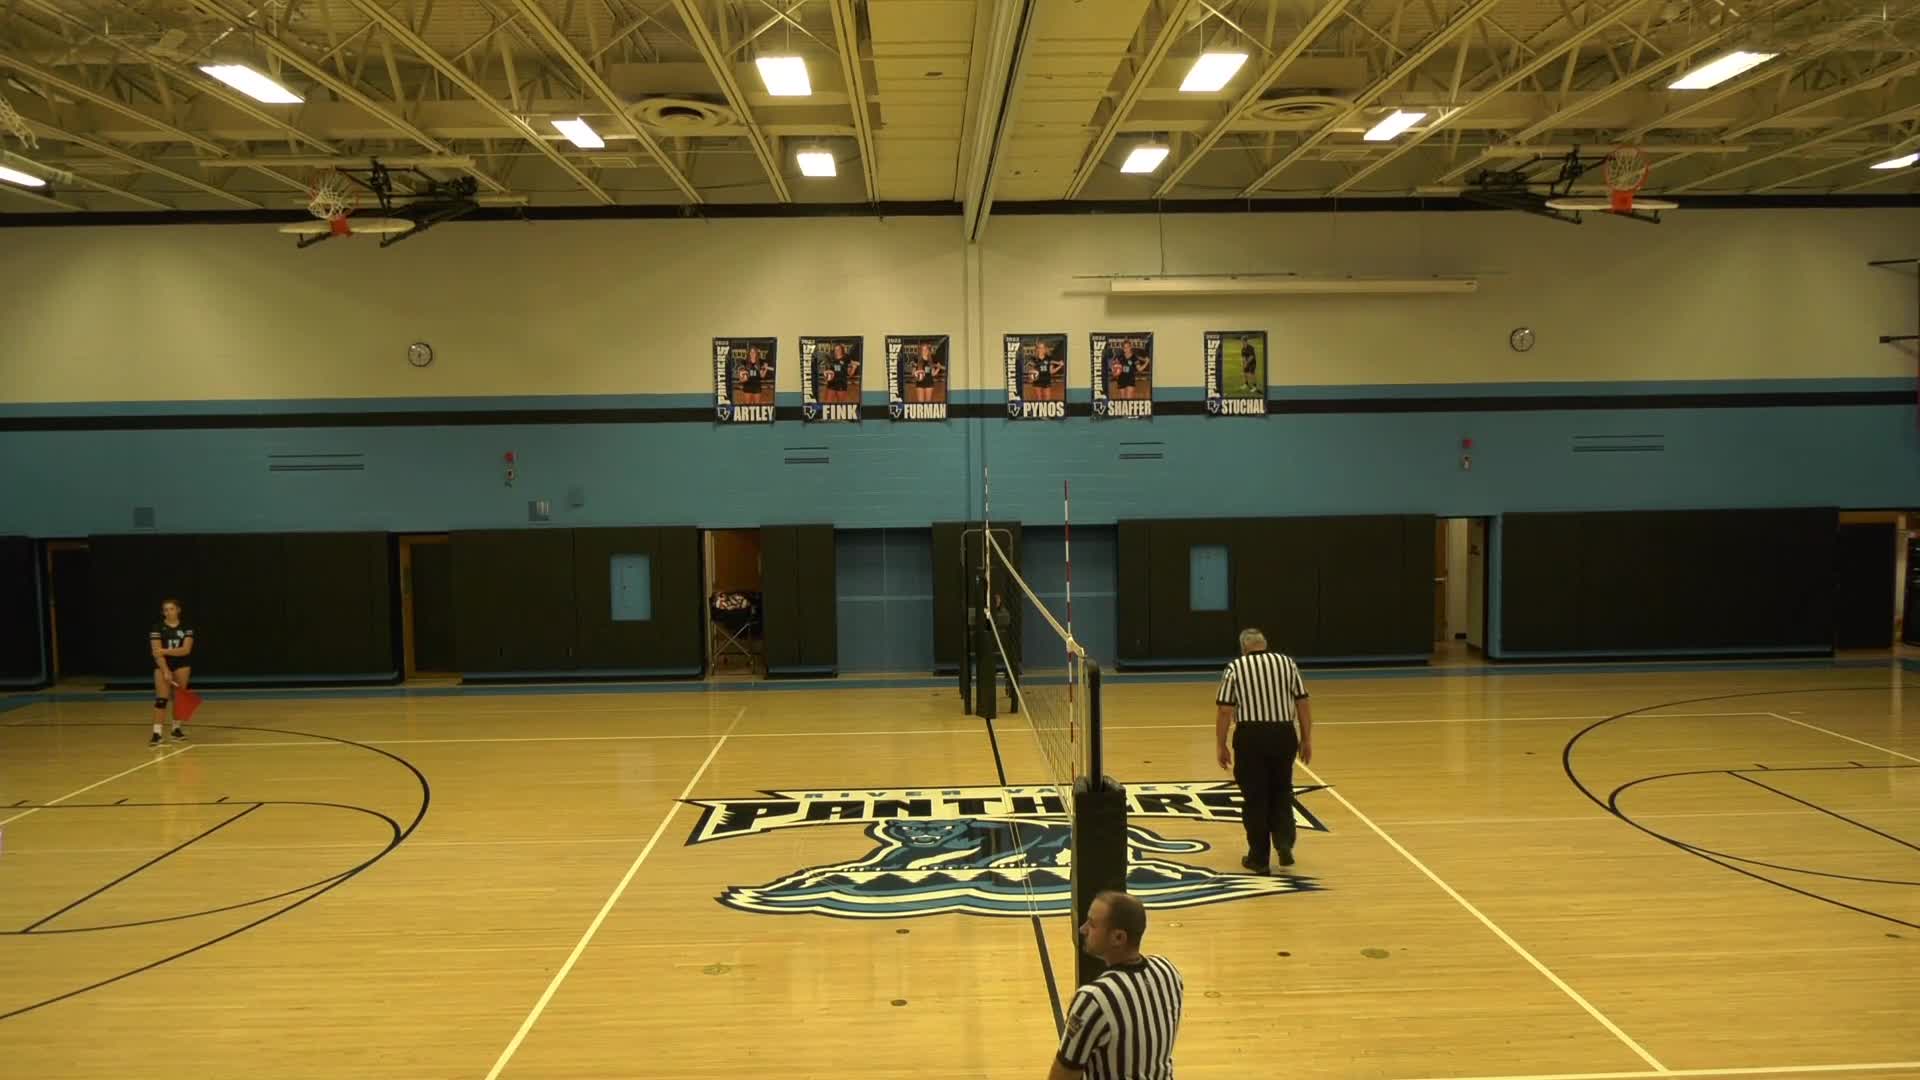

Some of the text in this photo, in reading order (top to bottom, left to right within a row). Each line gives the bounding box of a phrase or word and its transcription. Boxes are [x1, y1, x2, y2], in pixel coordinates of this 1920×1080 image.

[717, 346, 731, 405] PANTHERS
[803, 345, 817, 403] PANTHERS
[889, 344, 903, 402] PANTHERS
[1007, 342, 1021, 401] PANTHERS
[1093, 341, 1107, 400] PANTHERS
[1207, 340, 1221, 398] PANTHERS
[733, 405, 774, 421] ARTLEY
[822, 404, 858, 420] FINK
[904, 403, 947, 419] FURMAN
[1023, 401, 1065, 417] PYNOS
[1107, 400, 1152, 416] SHAFFER
[1221, 399, 1264, 415] STUCHAL
